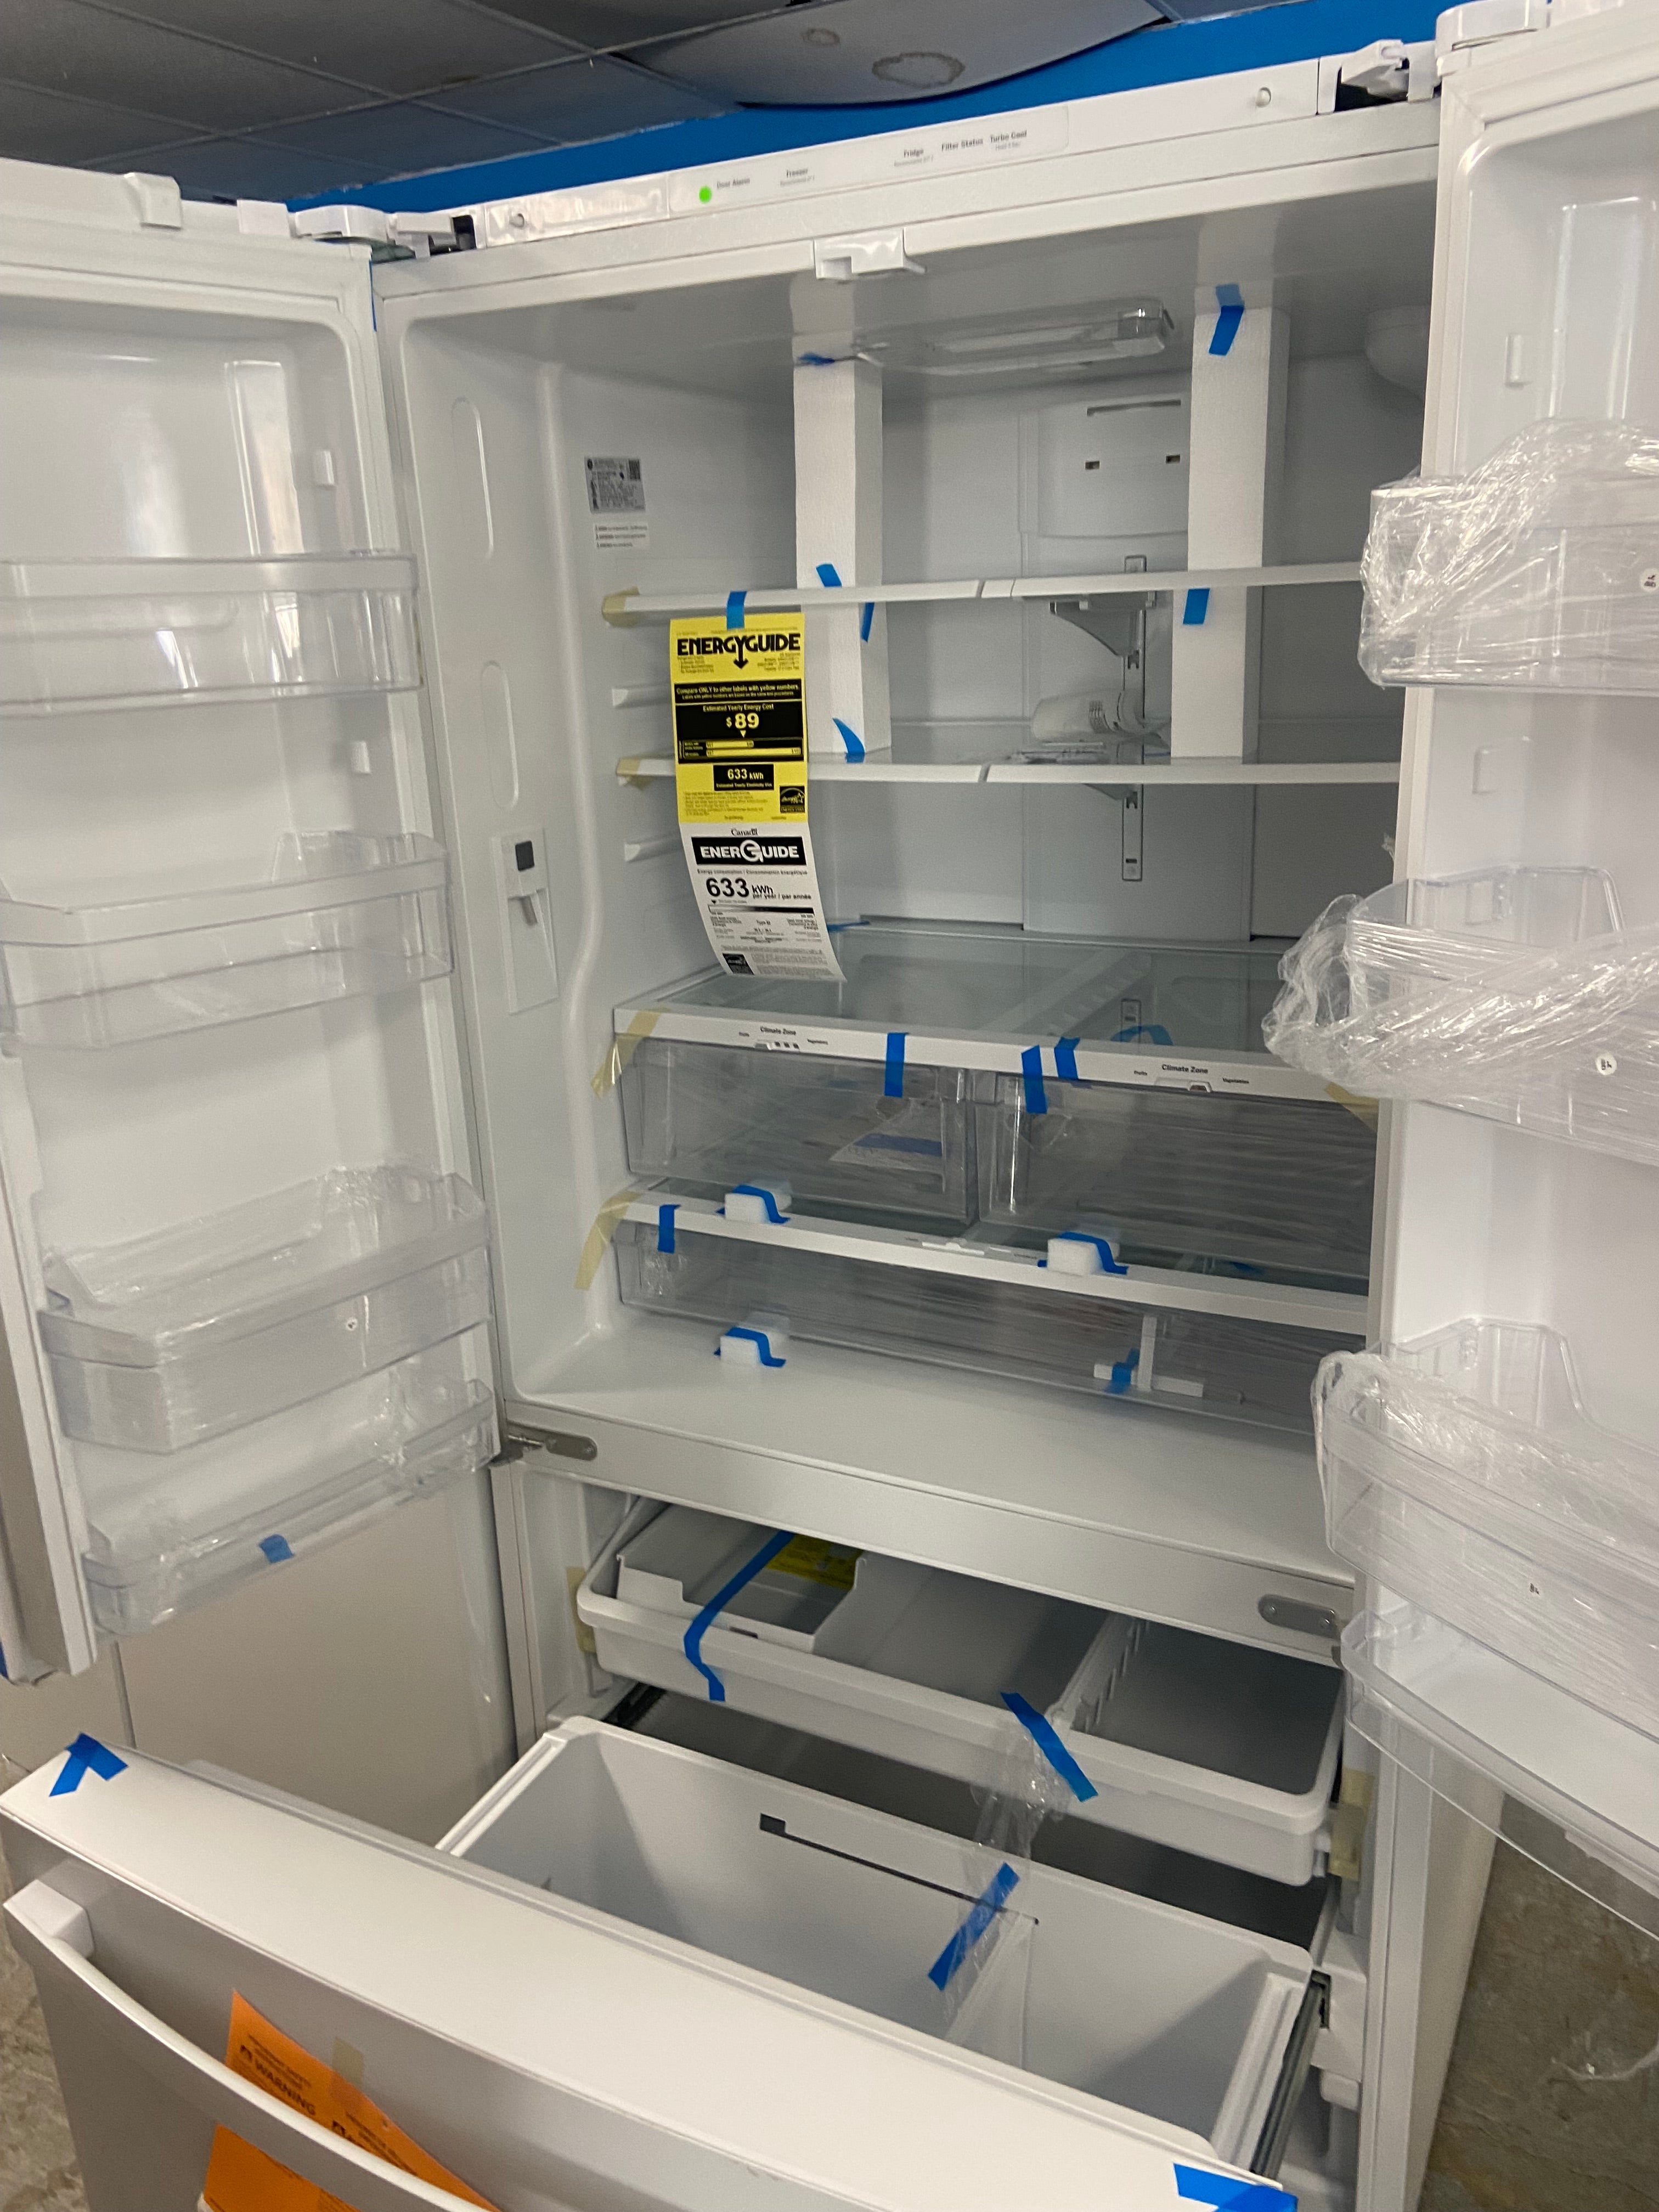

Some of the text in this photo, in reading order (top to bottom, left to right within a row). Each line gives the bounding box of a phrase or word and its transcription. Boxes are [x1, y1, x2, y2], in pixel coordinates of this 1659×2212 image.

[990, 132, 1009, 144] Turbo
[941, 142, 959, 151] Filter
[961, 138, 984, 149] Status
[903, 148, 924, 159] Fridge
[677, 633, 800, 658] ENERGYGUIDE
[743, 703, 761, 712] Energy
[726, 712, 760, 730] $ 89
[727, 768, 764, 780] 633 kWh
[699, 839, 799, 863] ENERGUIDE
[706, 877, 750, 898] 633
[752, 884, 774, 894] kWh
[760, 1026, 782, 1035] Climate
[1161, 1064, 1209, 1074] Climate Zone
[255, 2058, 317, 2116] WARNING
